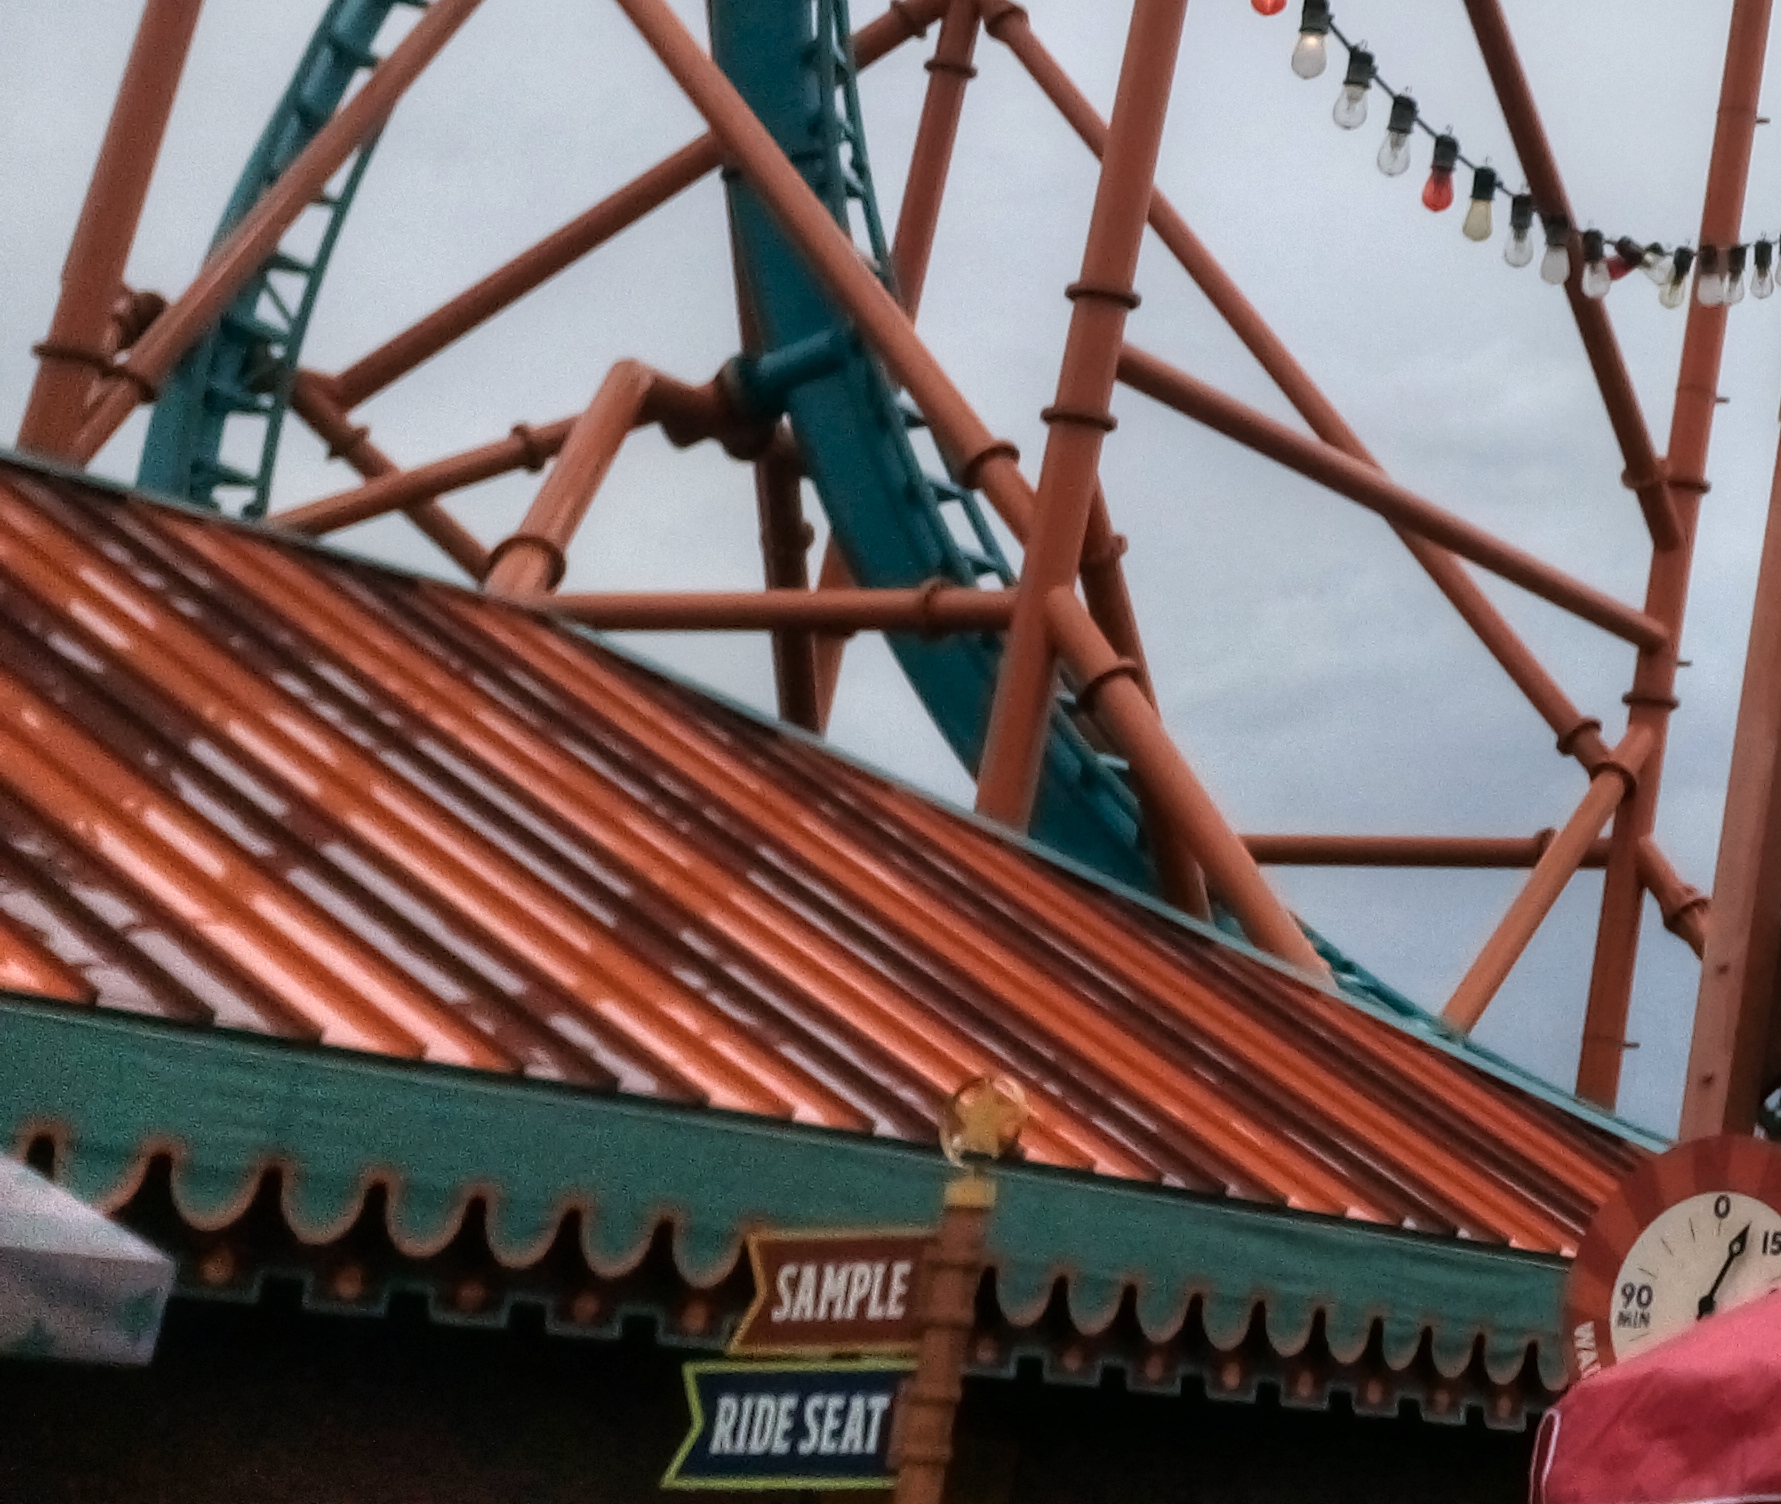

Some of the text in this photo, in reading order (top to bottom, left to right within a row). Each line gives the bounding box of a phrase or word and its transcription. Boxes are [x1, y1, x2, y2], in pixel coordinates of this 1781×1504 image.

[1713, 1194, 1731, 1219] 0
[771, 1259, 912, 1322] SAMPLE
[1621, 1282, 1653, 1310] 90
[1617, 1310, 1651, 1329] MIN
[709, 1392, 892, 1455] RIDE SEAT
